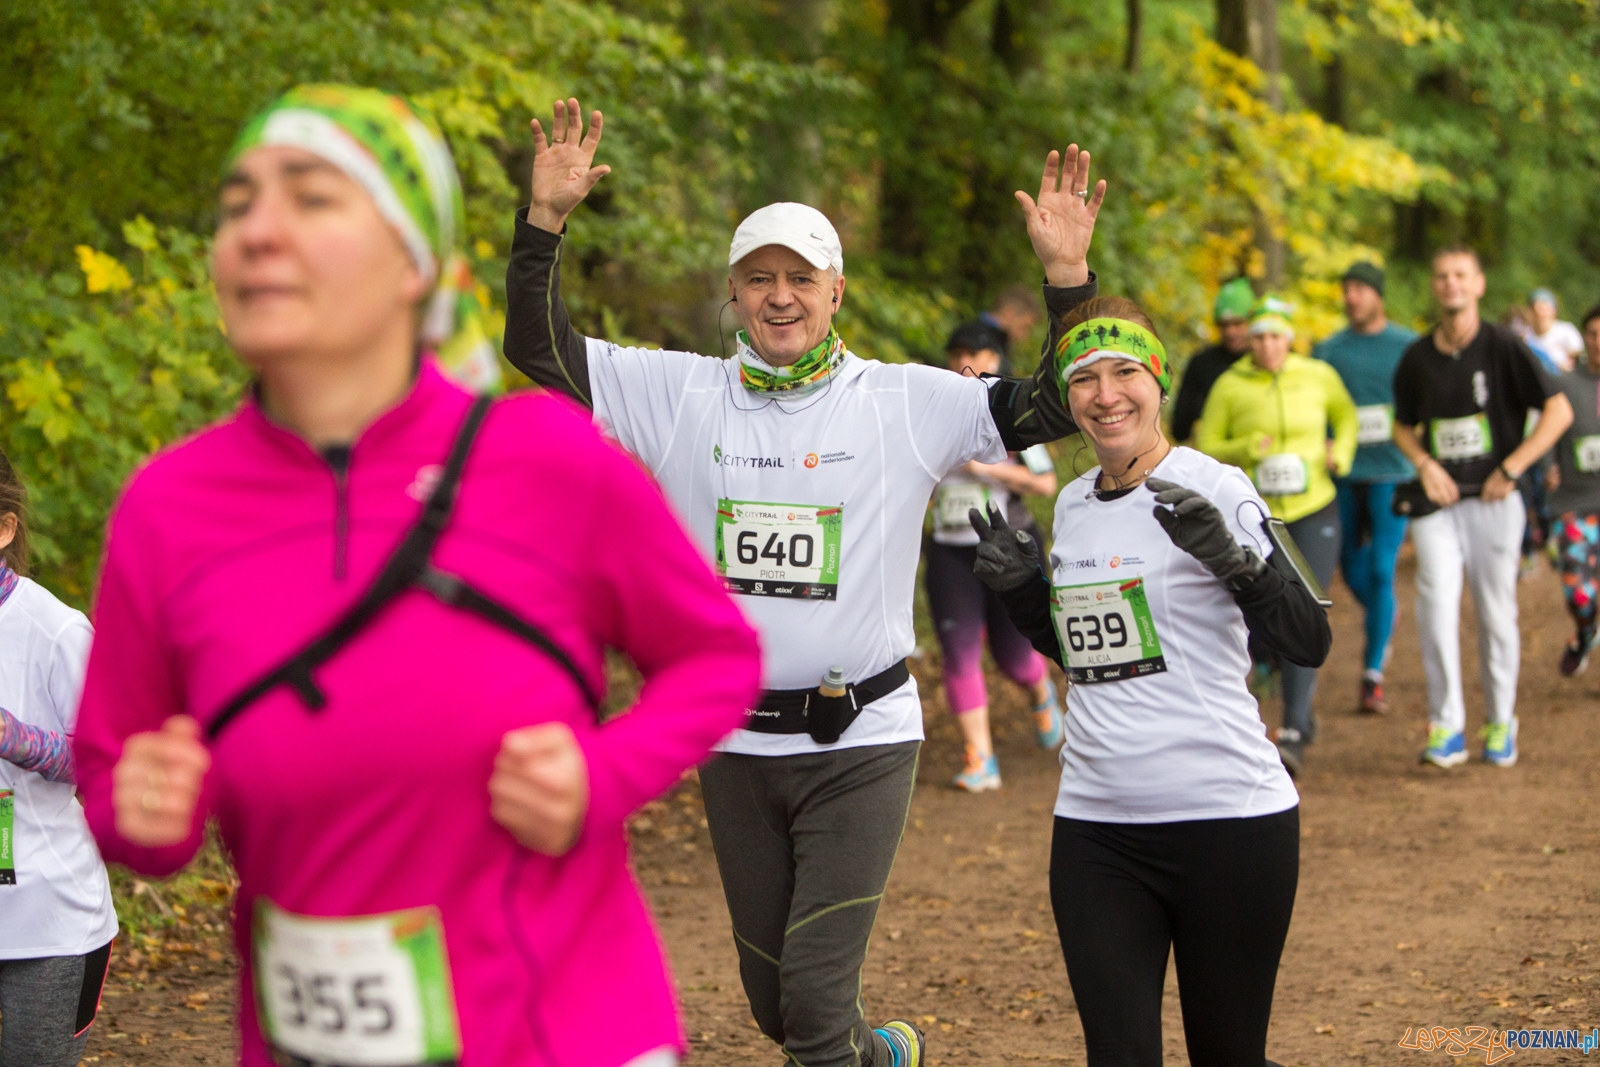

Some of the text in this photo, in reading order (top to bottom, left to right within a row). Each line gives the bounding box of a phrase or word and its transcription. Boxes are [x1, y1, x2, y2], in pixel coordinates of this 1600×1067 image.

[820, 450, 847, 459] nationale
[820, 454, 855, 465] nederlanden
[736, 530, 814, 568] 640
[826, 543, 836, 574] Poznań
[759, 569, 786, 580] PIOTR
[1066, 612, 1128, 652] 639
[1139, 616, 1154, 647] Poznań
[1087, 654, 1112, 664] ALICJA
[751, 709, 781, 718] Kalenji
[1, 827, 9, 859] Poznań
